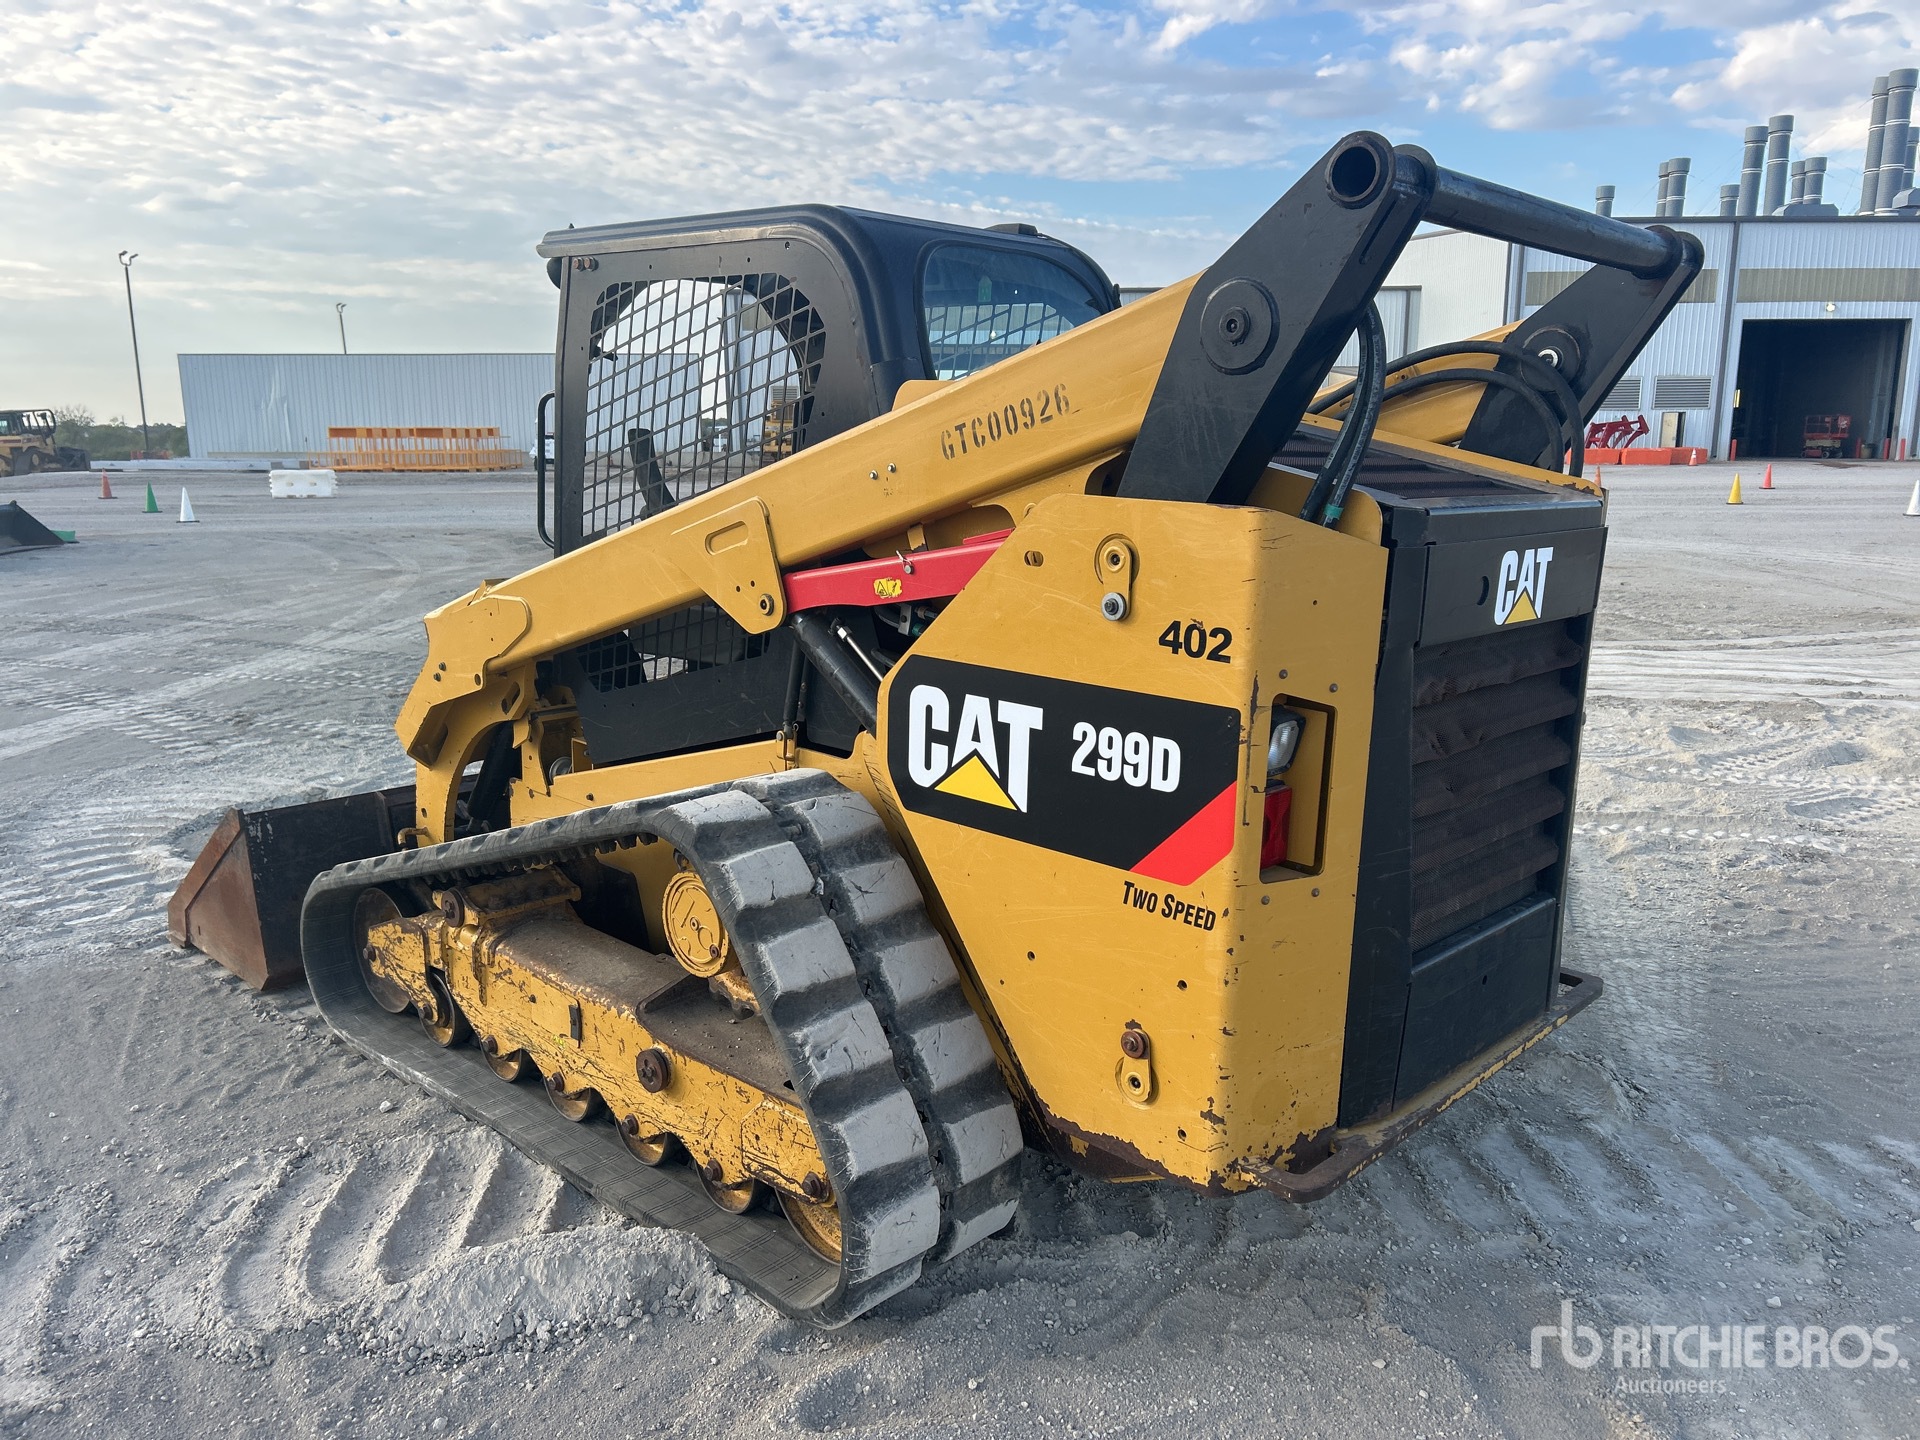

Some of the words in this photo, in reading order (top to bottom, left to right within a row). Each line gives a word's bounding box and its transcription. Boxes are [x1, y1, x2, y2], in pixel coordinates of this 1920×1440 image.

[940, 383, 1070, 460] GTC00926
[1494, 546, 1554, 625] CAT
[1158, 620, 1233, 664] 402
[908, 684, 1044, 814] CAT
[1071, 721, 1181, 793] 299D
